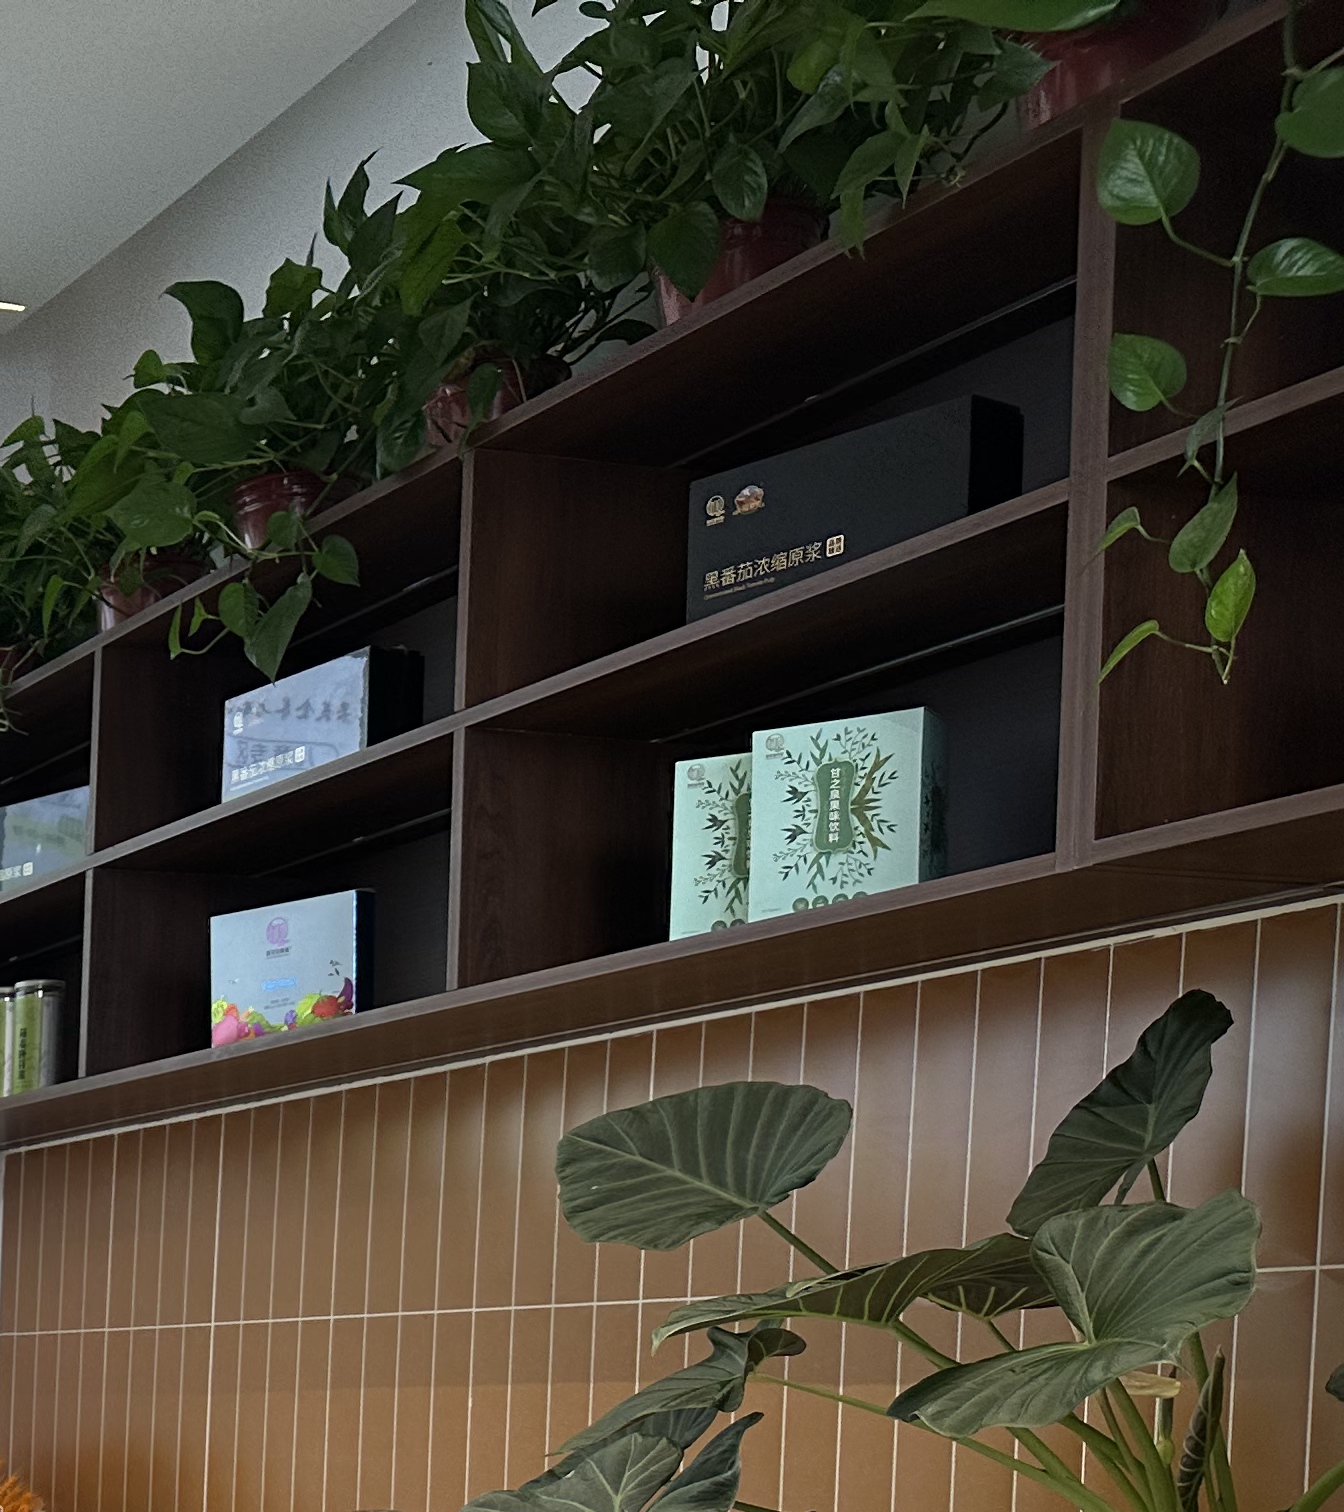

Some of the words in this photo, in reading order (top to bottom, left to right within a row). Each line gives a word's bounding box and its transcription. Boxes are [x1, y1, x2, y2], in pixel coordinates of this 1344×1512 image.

[703, 540, 823, 592] 黑番茄浓缩原浆
